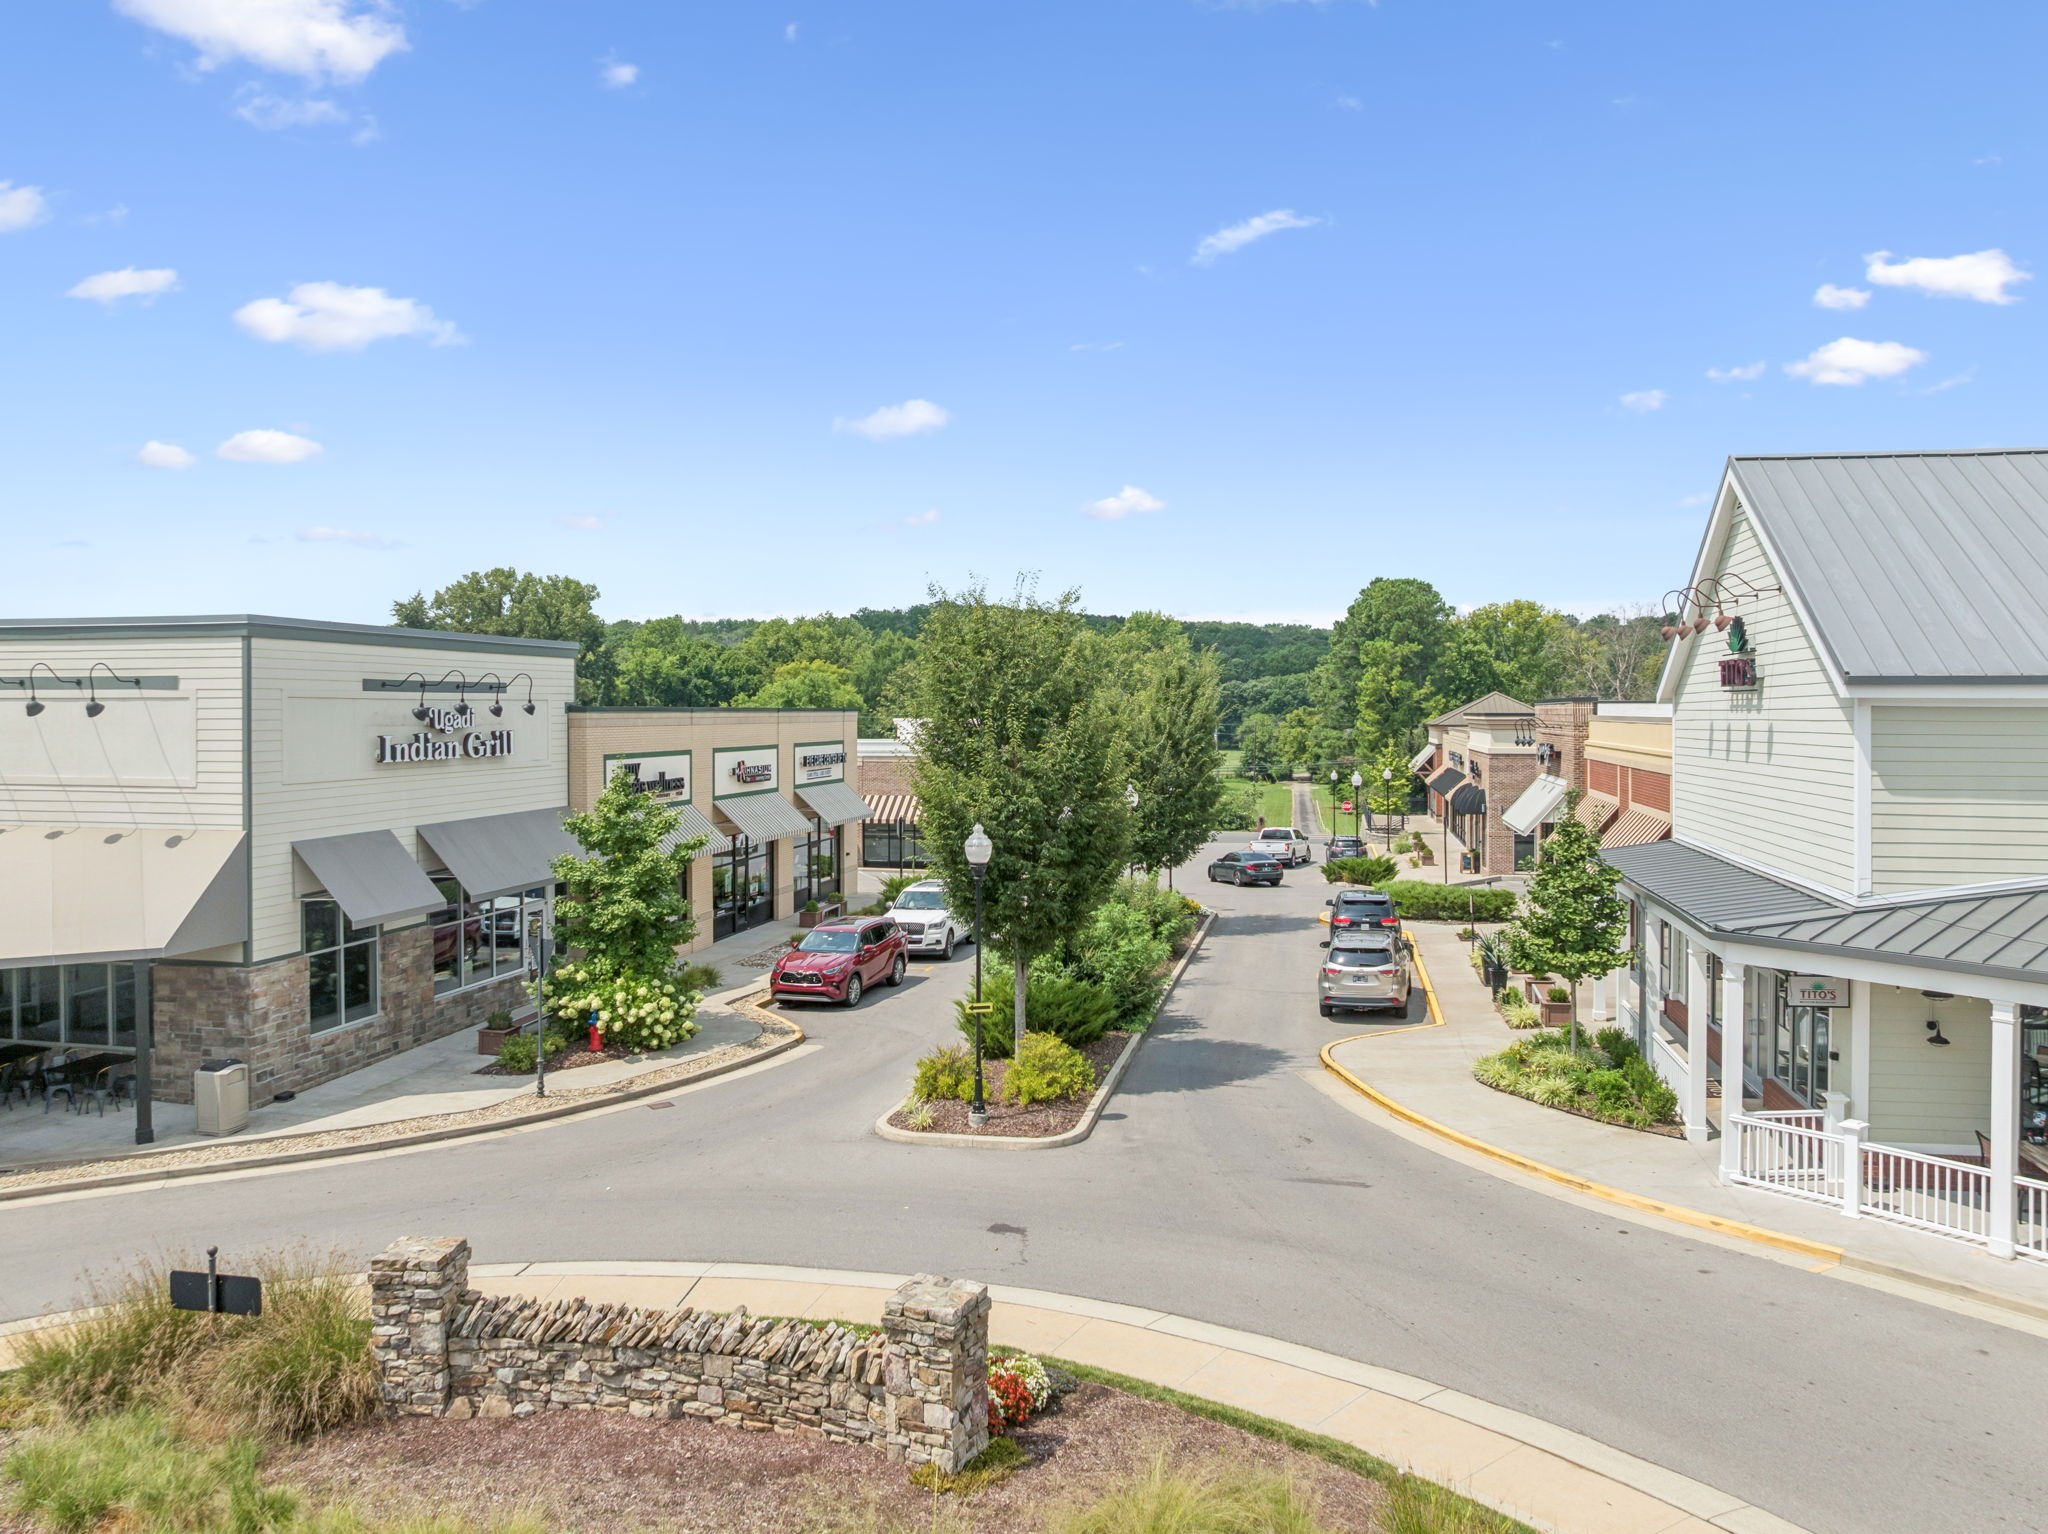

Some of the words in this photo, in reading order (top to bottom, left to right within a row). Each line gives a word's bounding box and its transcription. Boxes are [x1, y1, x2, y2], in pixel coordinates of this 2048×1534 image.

[428, 707, 475, 734] Ugadi
[379, 732, 462, 763] Indian
[465, 729, 514, 758] Grill
[1800, 990, 1837, 1000] TITO'S
